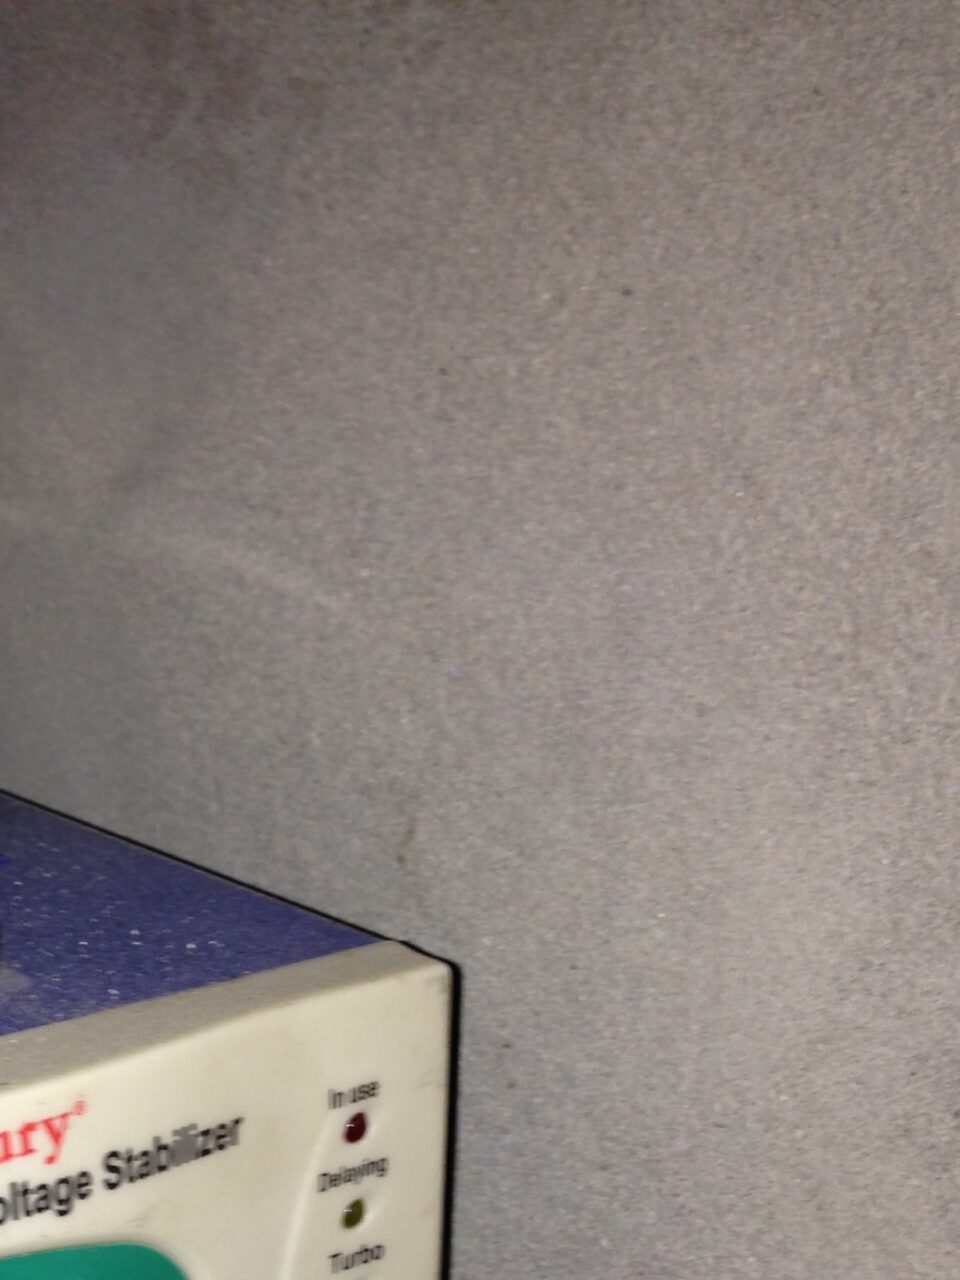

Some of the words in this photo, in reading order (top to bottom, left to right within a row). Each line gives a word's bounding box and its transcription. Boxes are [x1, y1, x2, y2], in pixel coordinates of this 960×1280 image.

[102, 1116, 245, 1190] Stabilizer
[317, 1157, 389, 1193] Delaying
[328, 1244, 386, 1274] Turbo
